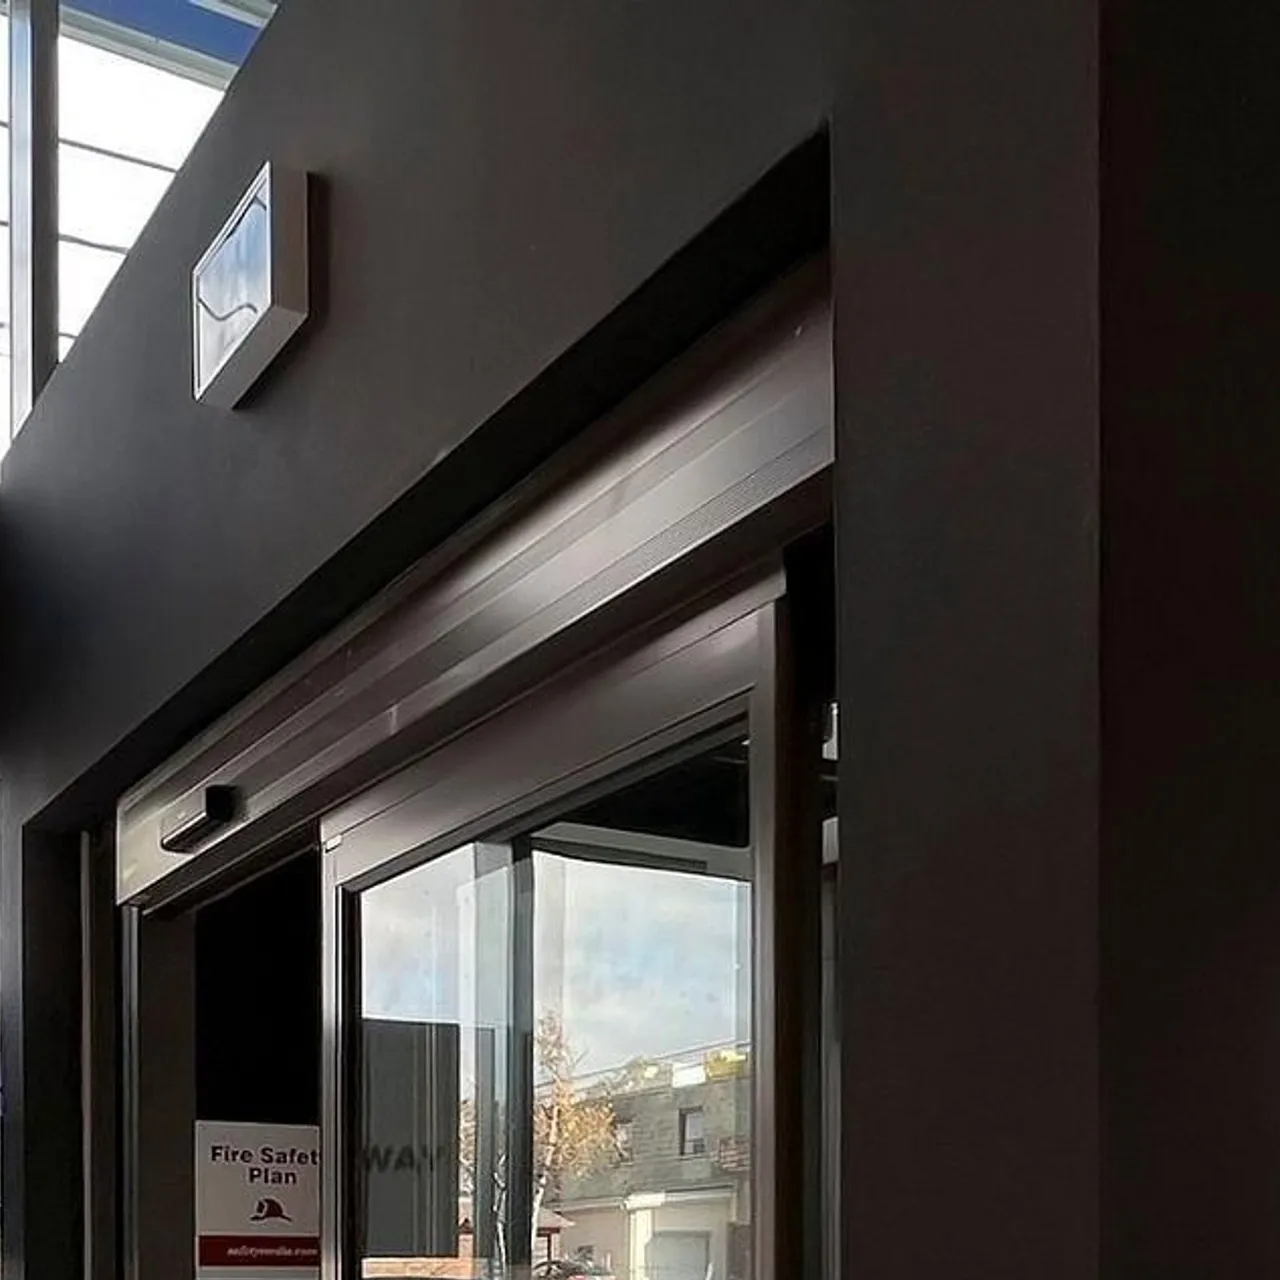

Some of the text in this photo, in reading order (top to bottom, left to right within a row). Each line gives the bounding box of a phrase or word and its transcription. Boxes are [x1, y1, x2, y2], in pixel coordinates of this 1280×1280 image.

[211, 1146, 319, 1165] Fire Safet
[249, 1167, 297, 1184] Plan
